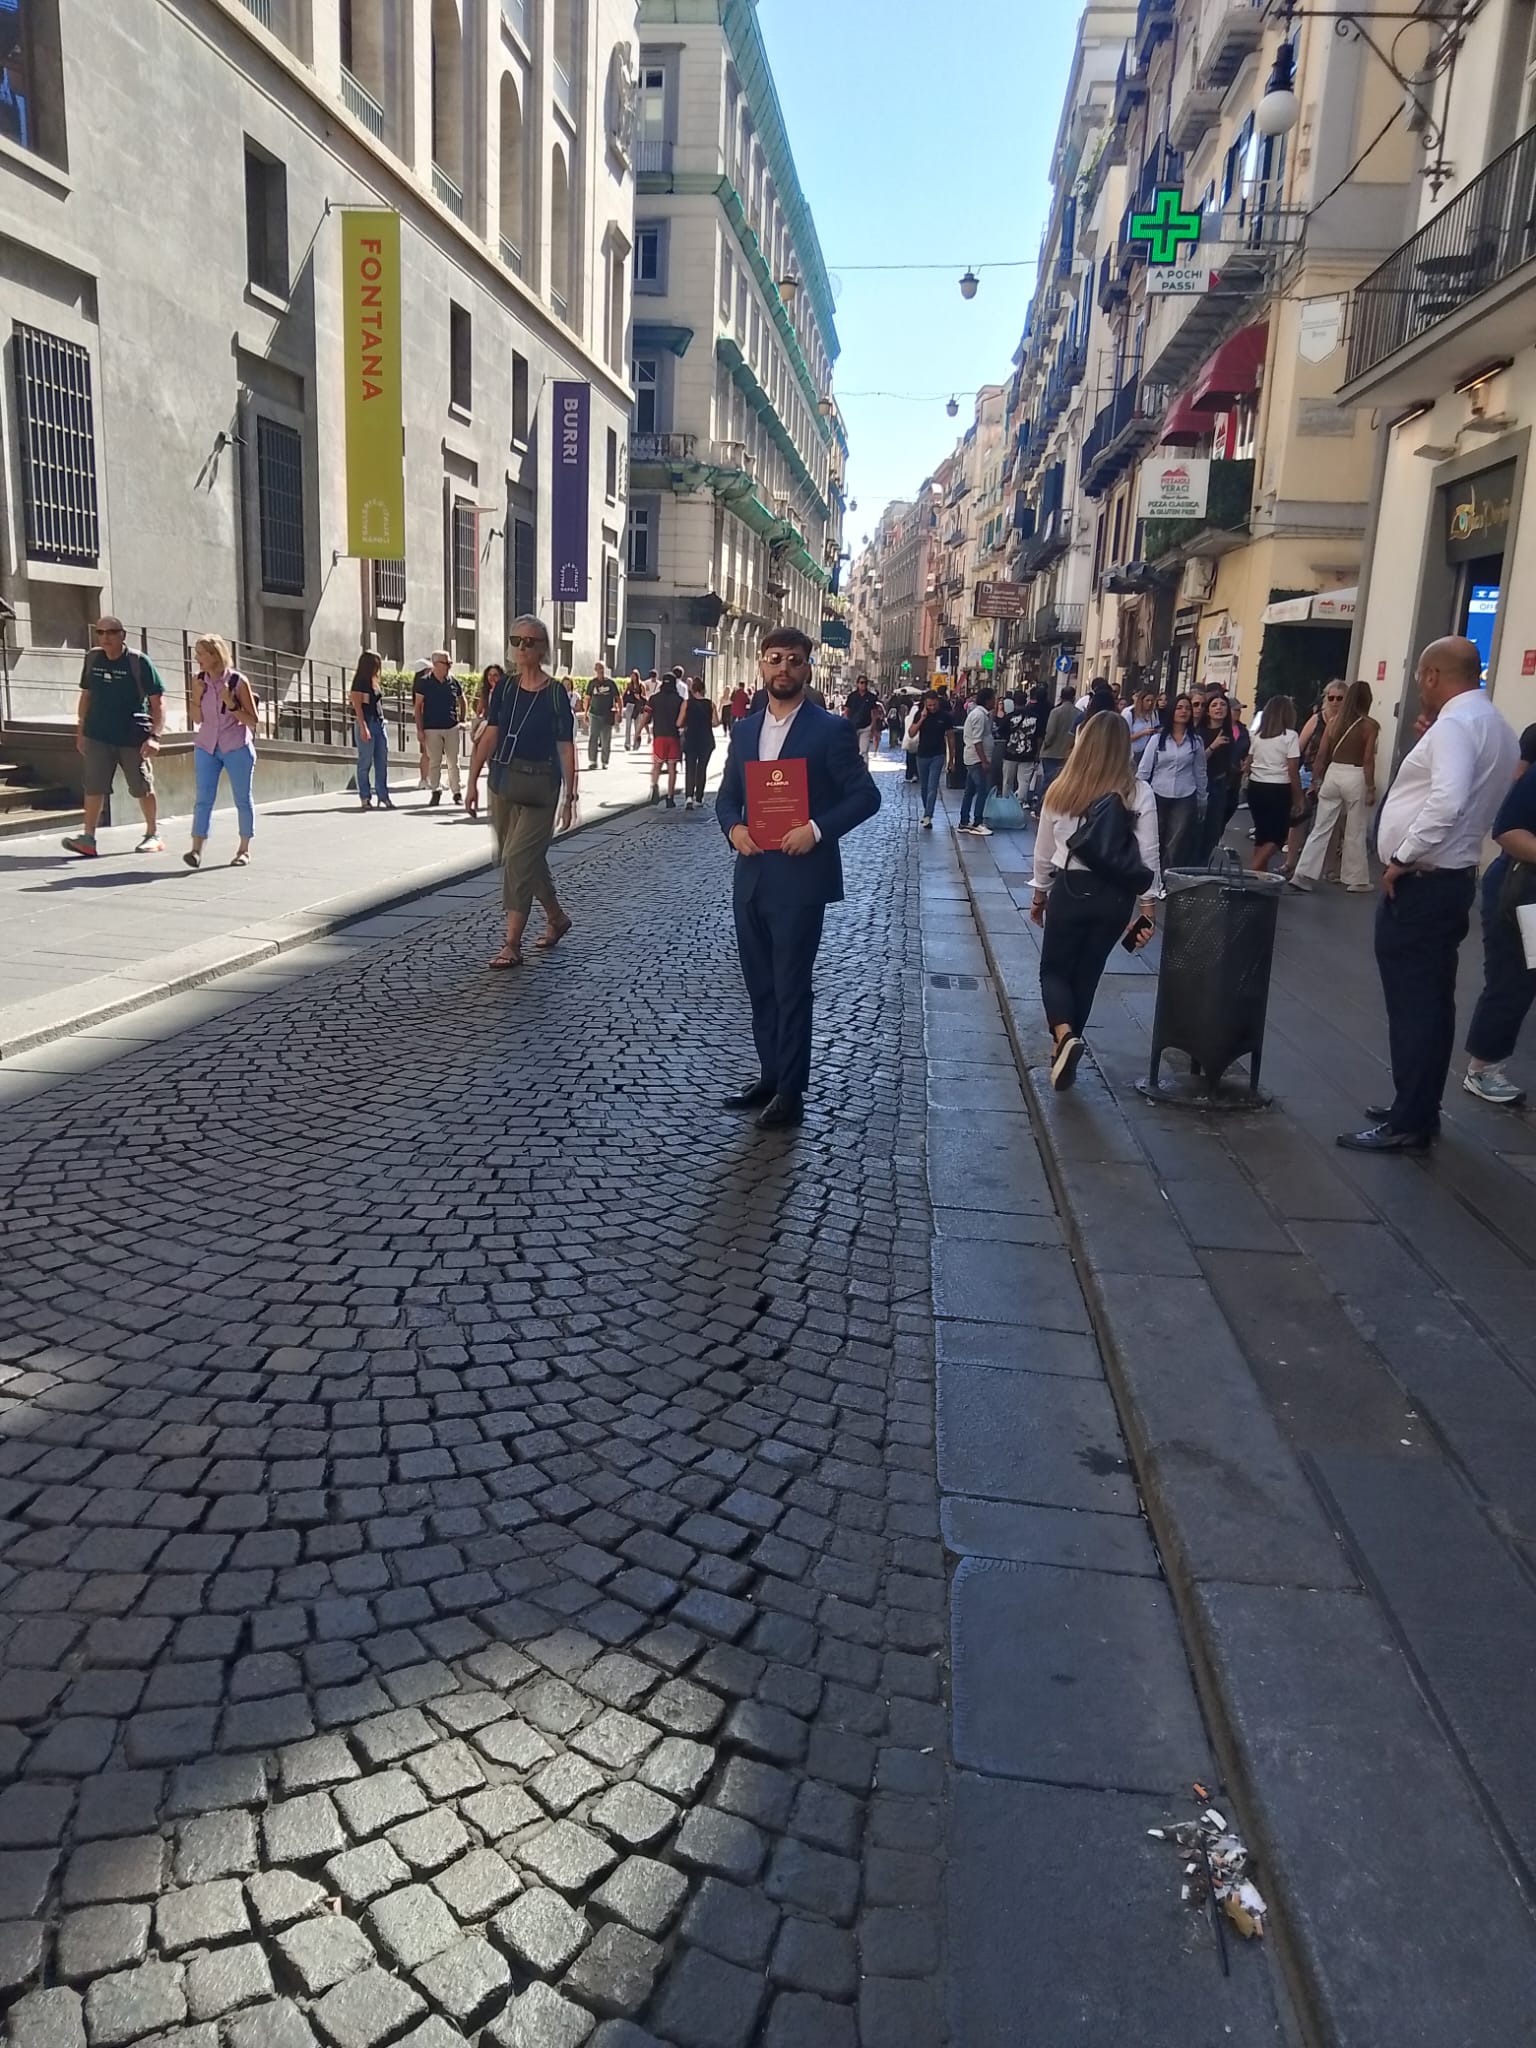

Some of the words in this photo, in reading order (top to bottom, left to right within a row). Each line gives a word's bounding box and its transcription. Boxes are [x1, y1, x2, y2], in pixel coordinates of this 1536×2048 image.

[1155, 270, 1164, 279] A
[1167, 270, 1203, 279] POCHI
[1161, 281, 1195, 290] PASSI
[360, 239, 383, 401] FONTANA
[563, 398, 579, 464] BURRI
